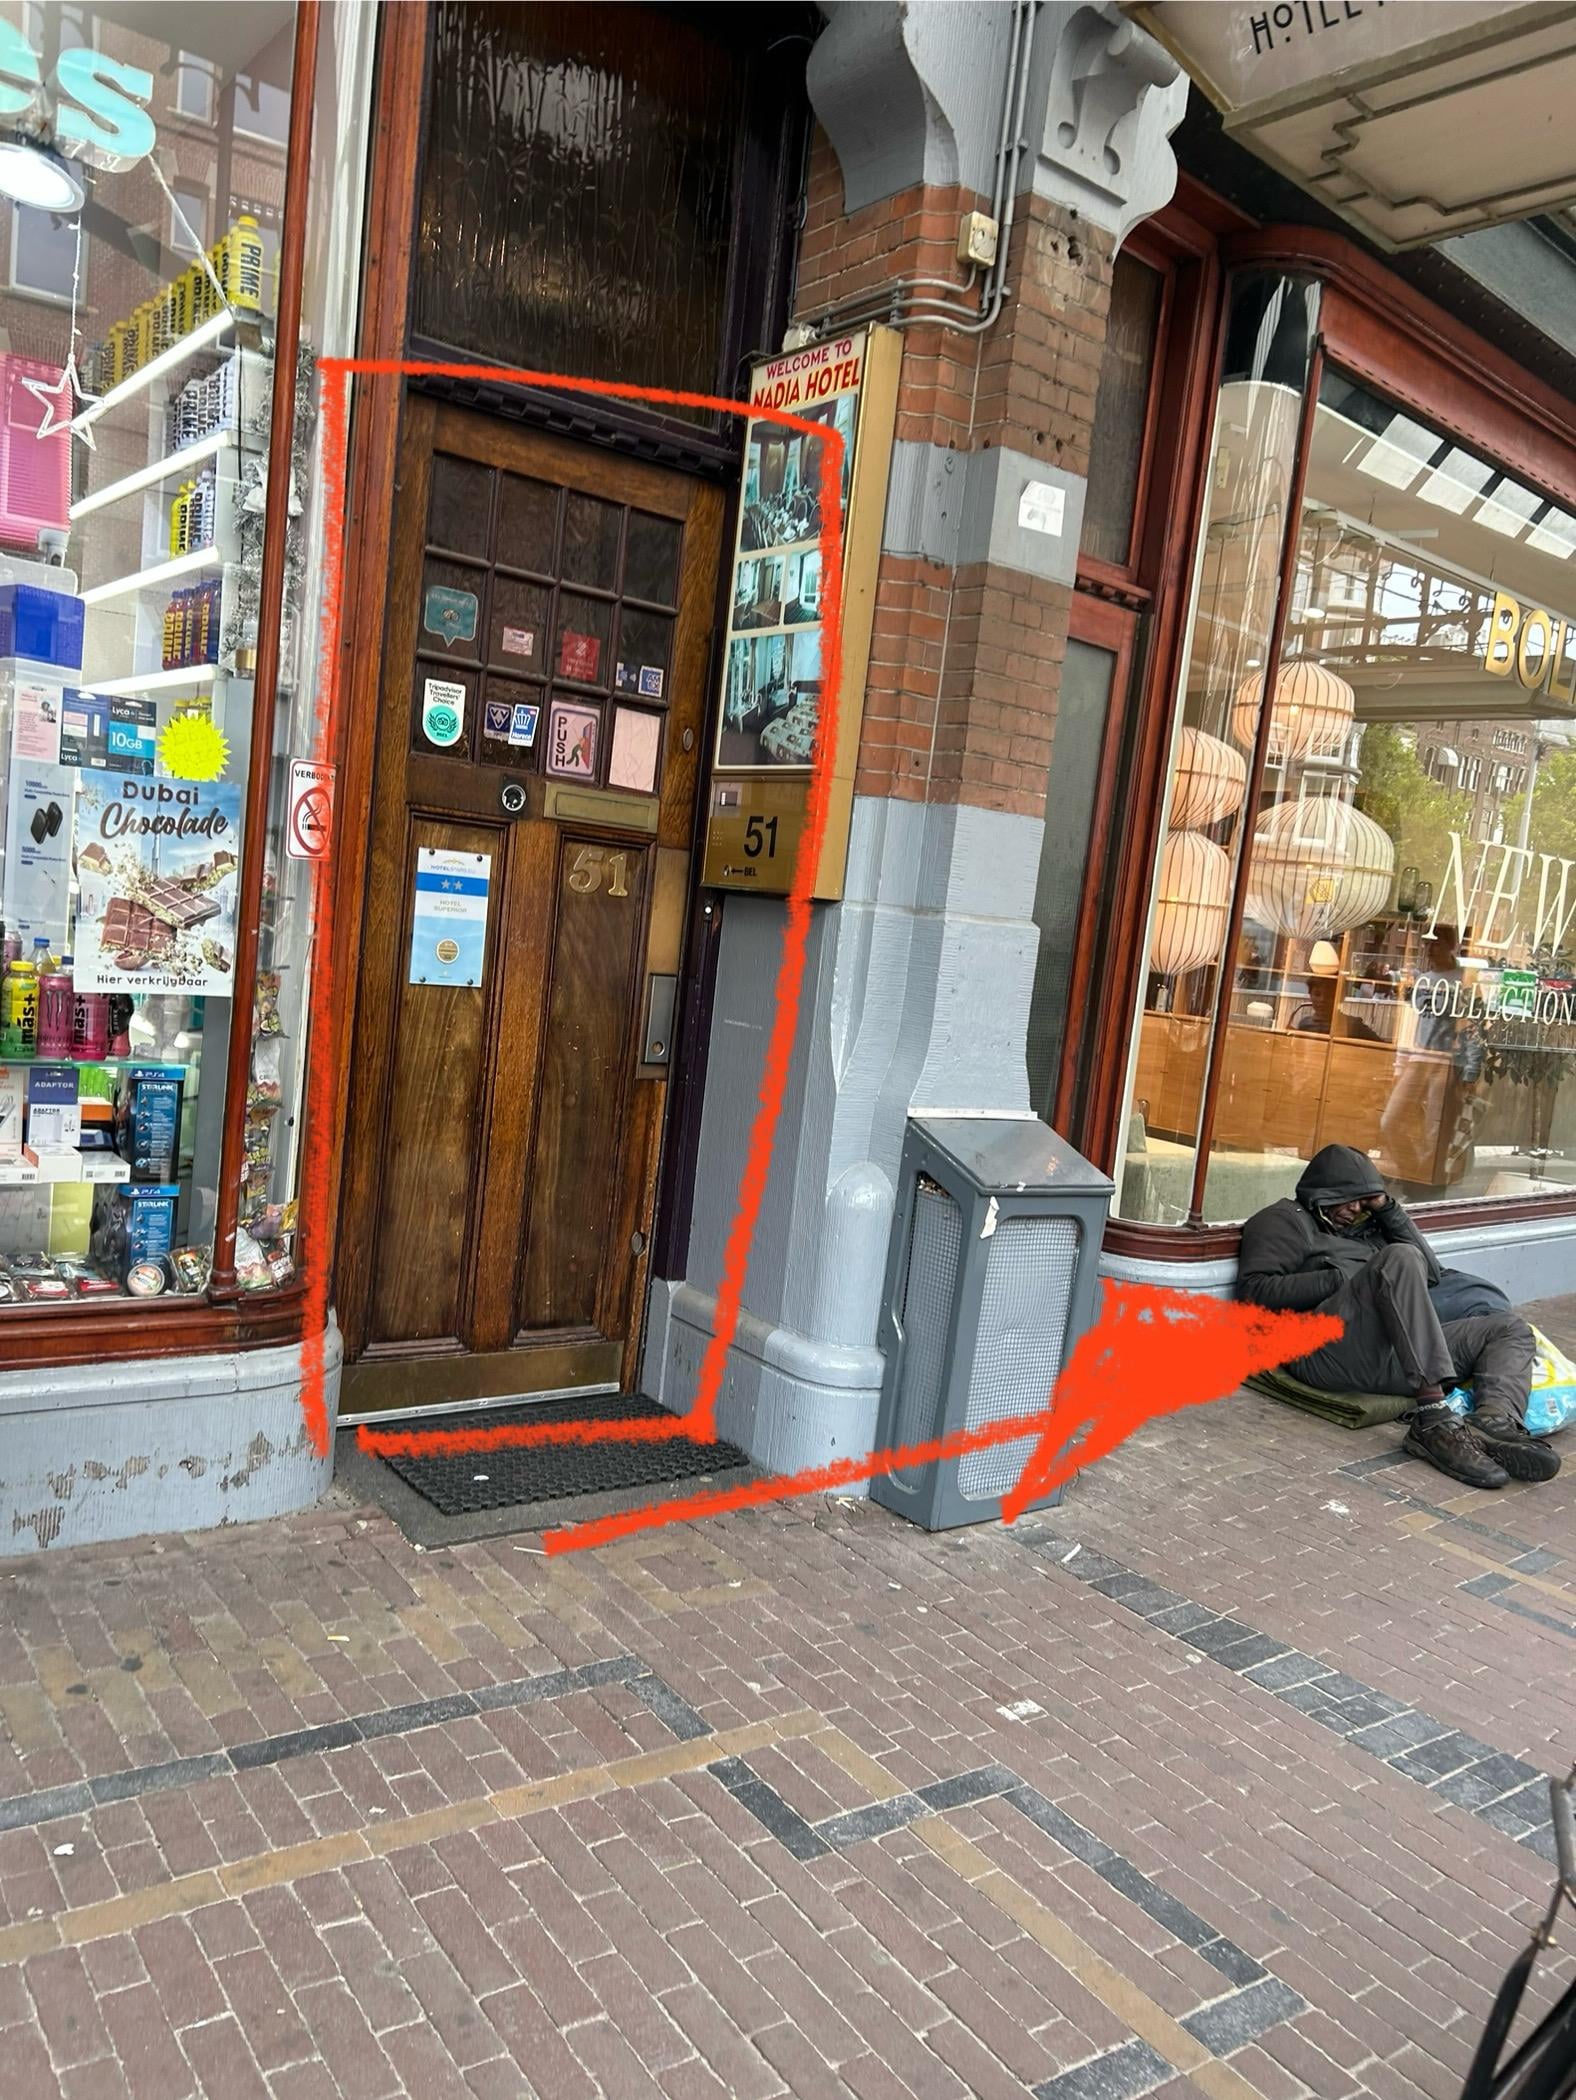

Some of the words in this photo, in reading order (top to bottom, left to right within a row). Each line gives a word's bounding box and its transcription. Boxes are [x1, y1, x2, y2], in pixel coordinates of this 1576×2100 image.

[241, 242, 262, 299] PRIME
[766, 346, 829, 380] WELCOME
[834, 338, 852, 359] TO
[753, 376, 801, 409] NADIA
[805, 358, 860, 400] HOTEL
[1485, 592, 1576, 703] BOL
[429, 682, 462, 694] Tripadvisor
[432, 696, 455, 705] Choice
[111, 731, 143, 750] 10GB
[554, 716, 568, 767] PUSH
[122, 780, 199, 806] Dubai
[99, 801, 229, 840] Chocolade
[743, 815, 778, 858] 51
[569, 849, 628, 897] 51
[744, 866, 757, 877] BEL
[1421, 831, 1576, 958] NEW
[96, 974, 123, 985] Hier
[127, 975, 209, 988] verkrijgbaar
[1411, 976, 1576, 1026] COLLECTION
[34, 1081, 74, 1089] ADAPTOR
